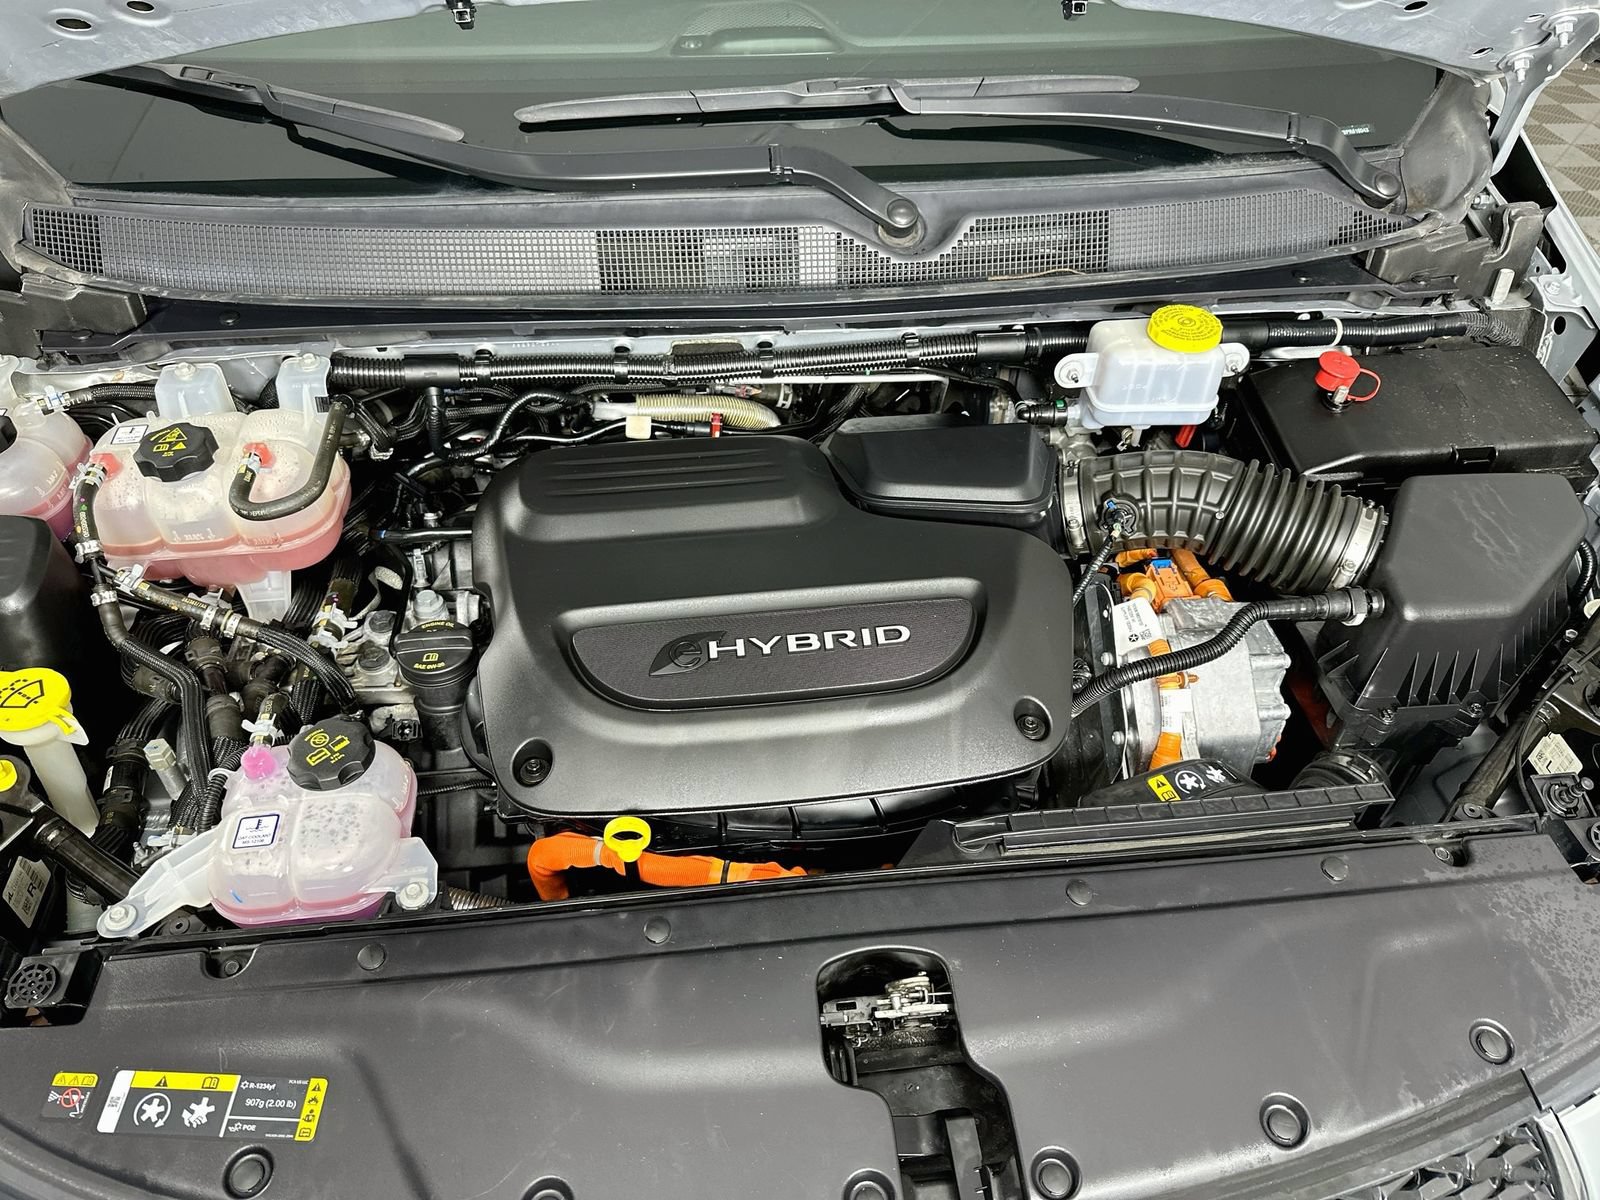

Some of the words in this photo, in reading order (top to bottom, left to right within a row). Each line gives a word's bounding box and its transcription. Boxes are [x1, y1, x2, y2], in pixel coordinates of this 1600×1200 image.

[421, 621, 445, 629] ENGINE
[707, 624, 911, 660] HYBRID
[249, 1082, 276, 1091] R-1234yf
[245, 1098, 265, 1109] 907g
[265, 1099, 285, 1109] (2.00
[286, 1100, 297, 1110] lb)
[242, 1124, 256, 1132] POE
